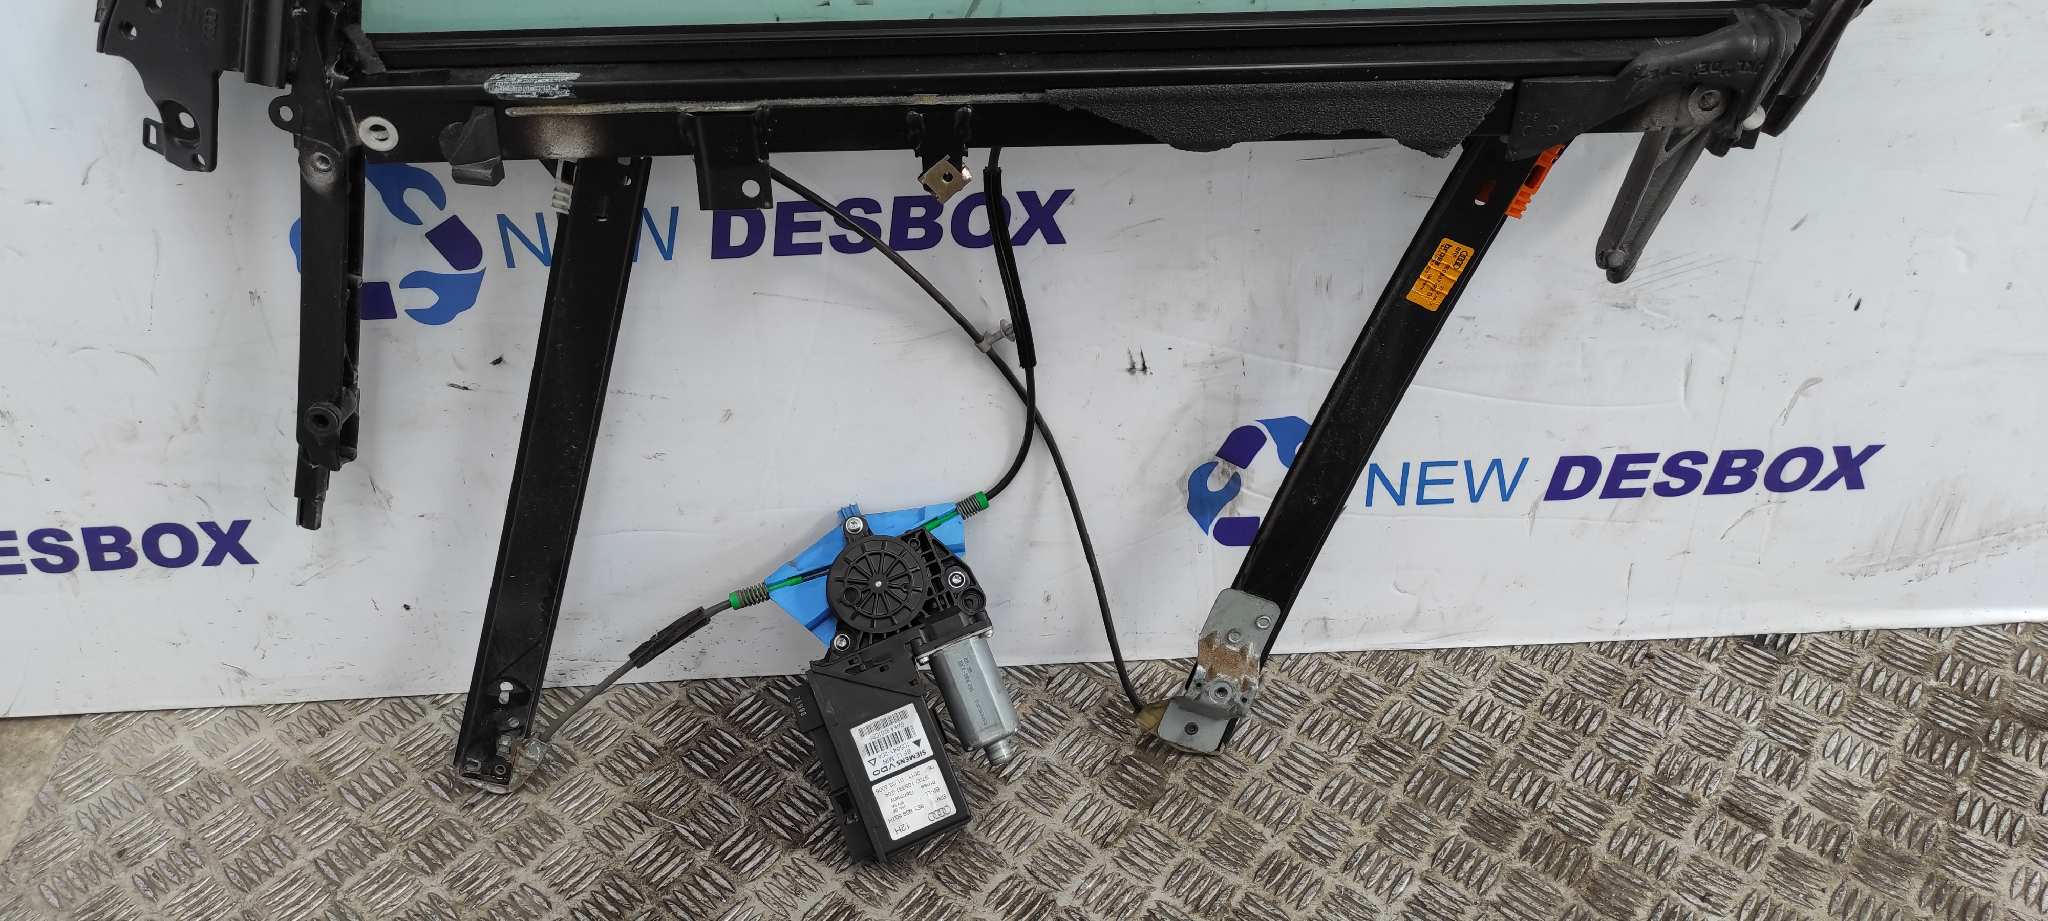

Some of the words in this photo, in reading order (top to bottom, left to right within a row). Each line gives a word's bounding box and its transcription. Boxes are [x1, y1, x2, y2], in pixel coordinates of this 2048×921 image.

[496, 206, 679, 269] NW
[710, 189, 1074, 260] DESBOX
[1365, 457, 1530, 507] NEW
[1543, 444, 1885, 501] DESBOX
[871, 762, 895, 777] VDO
[895, 748, 926, 766] SIEMENS
